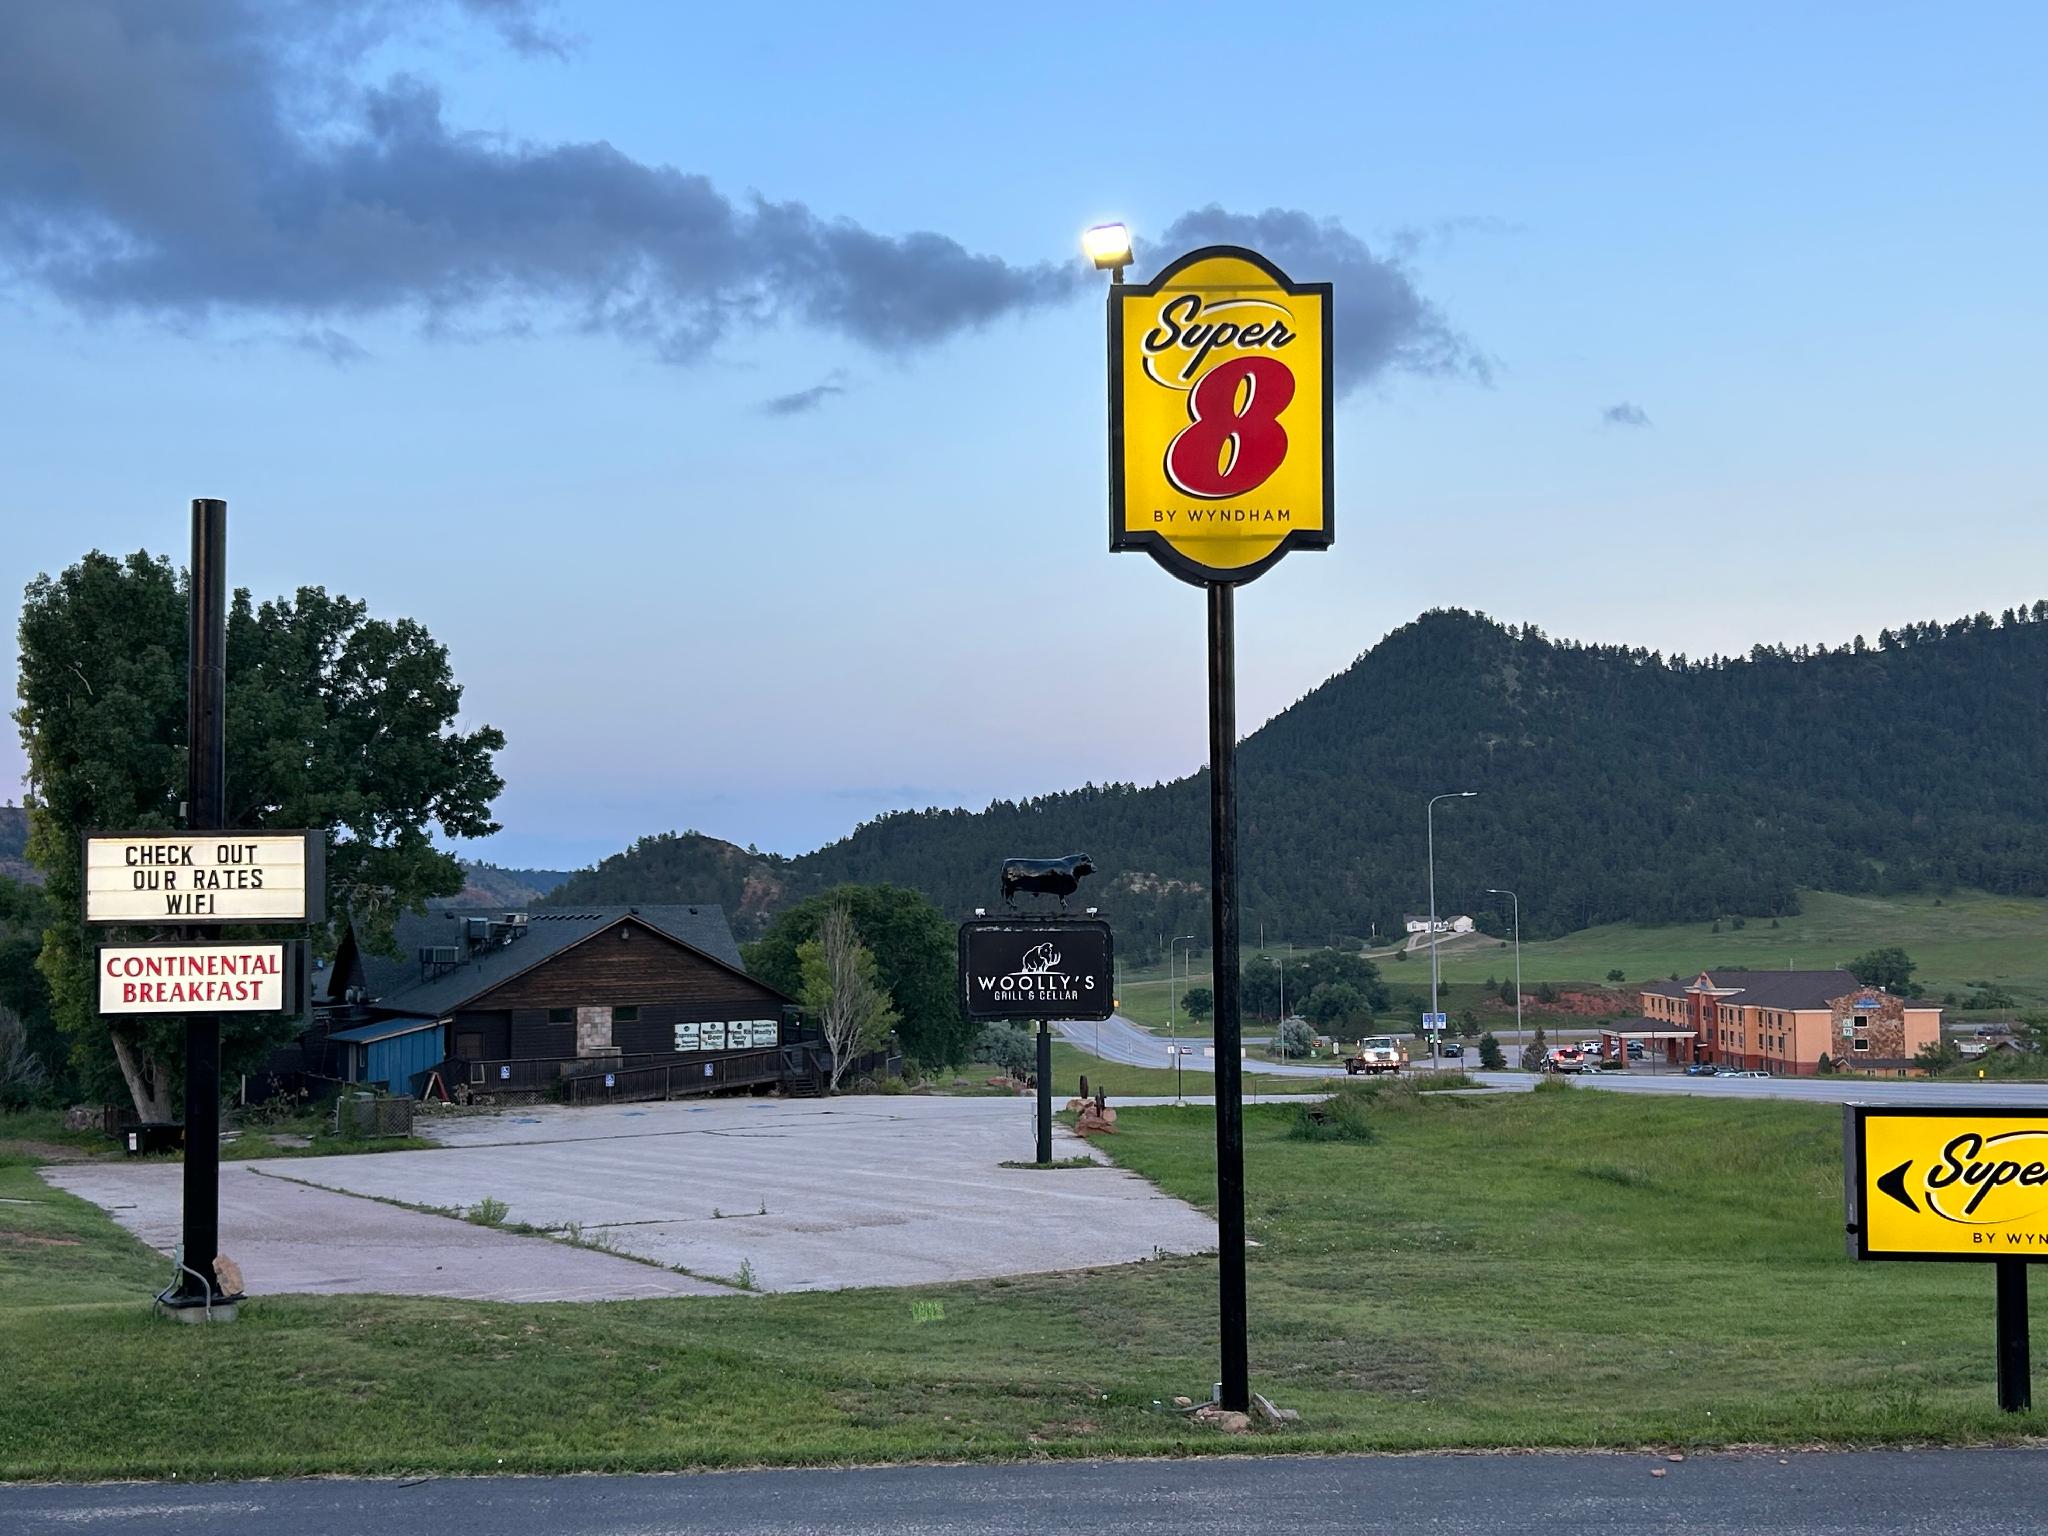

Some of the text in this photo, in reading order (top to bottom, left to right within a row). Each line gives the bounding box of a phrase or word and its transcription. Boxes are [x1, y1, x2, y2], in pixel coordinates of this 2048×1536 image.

[1145, 294, 1296, 380] Super
[1163, 355, 1296, 500] 8
[1154, 509, 1291, 522] BY WYNDHAM
[125, 844, 258, 866] CHECK OUT
[133, 869, 263, 890] OUR RATES
[165, 894, 216, 915] WIFI
[106, 954, 281, 977] CONTINENTAL
[123, 980, 264, 1003] BREAKFAST
[978, 976, 1095, 990] WOOLLY'S
[994, 991, 1079, 1000] GRILL & CELLAR
[1973, 1232, 1996, 1244] BY
